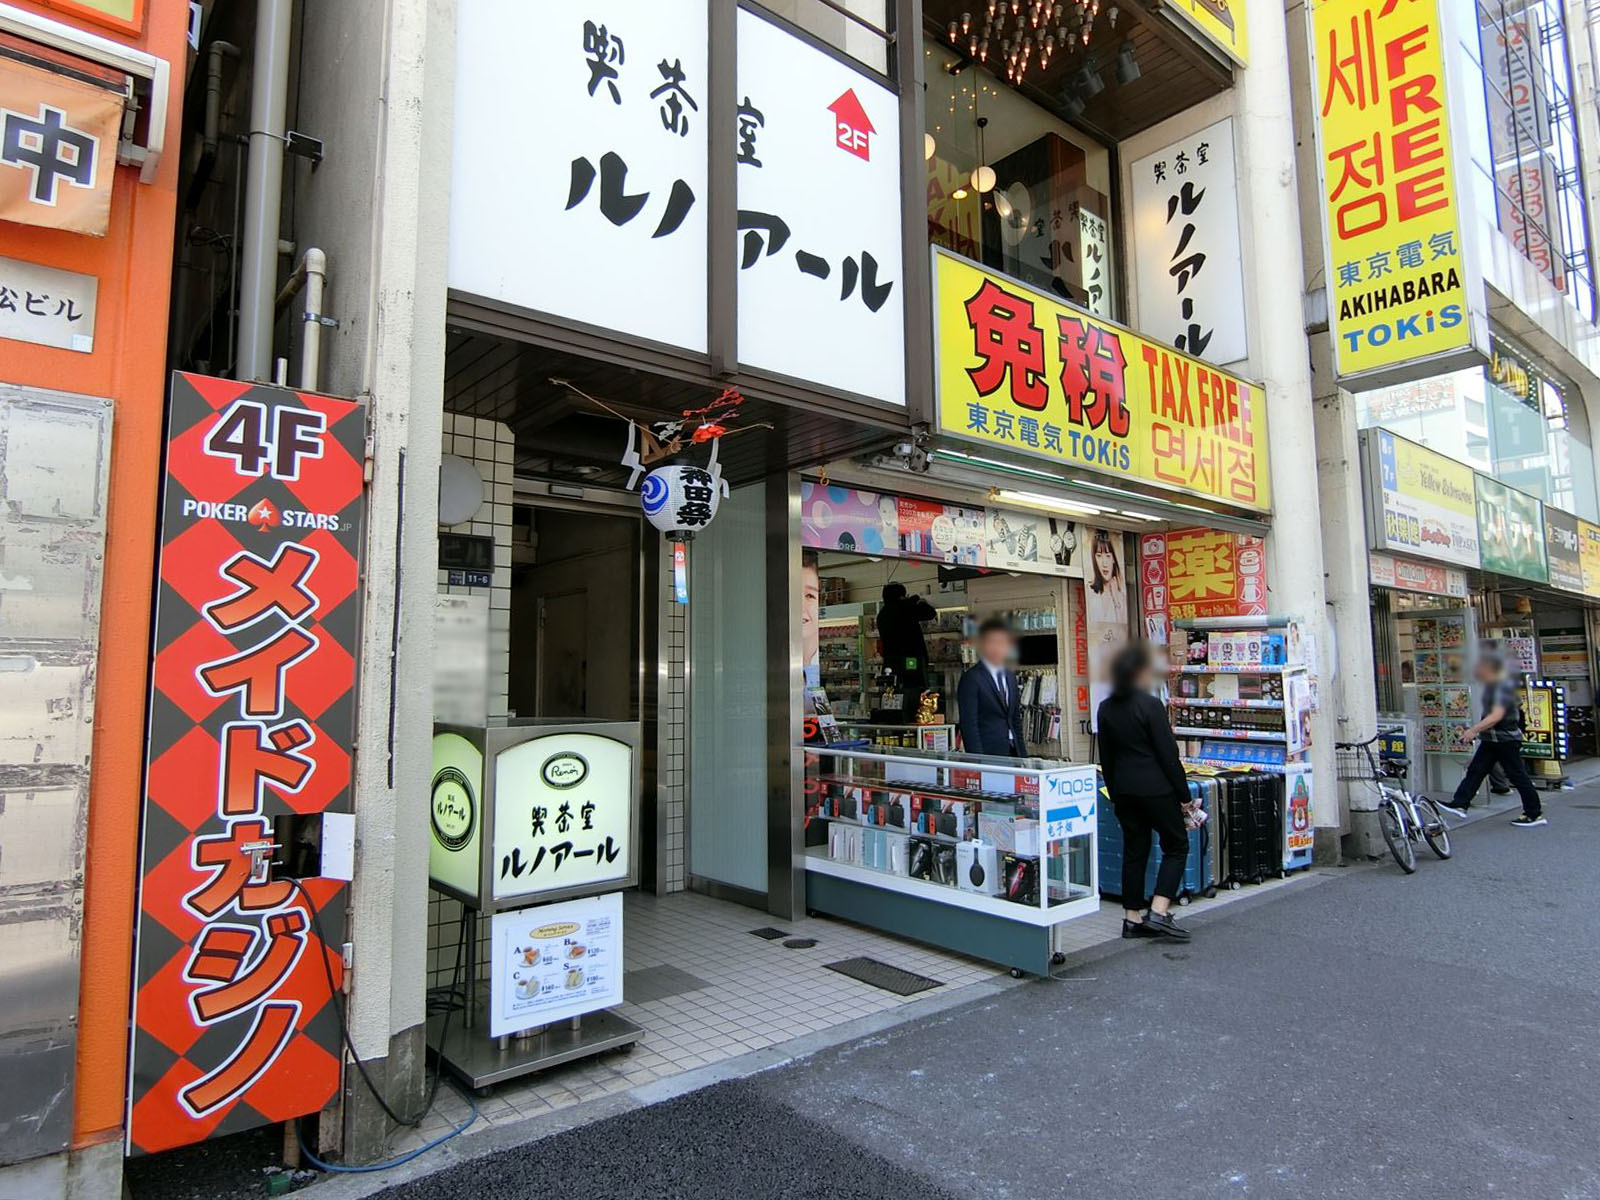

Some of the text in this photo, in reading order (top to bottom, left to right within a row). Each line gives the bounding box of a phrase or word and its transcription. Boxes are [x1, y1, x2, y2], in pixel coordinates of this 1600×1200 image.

[583, 19, 765, 168] 喫茶室
[1, 103, 99, 207] 中
[837, 121, 868, 150] 2F
[1153, 142, 1210, 184] 喫茶室
[564, 150, 895, 313] ルノアール
[1337, 230, 1458, 288] 東京電気
[1166, 182, 1214, 357] ルノアール
[1339, 267, 1461, 322] AKIHABARA
[963, 277, 1131, 439] 免税
[1343, 303, 1464, 353] TOKiS
[1141, 343, 1254, 448] TAX FREE
[203, 399, 328, 482] 4F
[966, 402, 1131, 471] 東京電気 TOKiS
[183, 499, 248, 522] POKER
[282, 509, 340, 532] STARS
[676, 466, 714, 527] 神田祭
[468, 574, 489, 584] 11-6
[1168, 531, 1235, 600] 薬
[1058, 777, 1095, 796] IQOS
[177, 541, 320, 1119] メイドカジノ
[532, 800, 597, 838] 喫茶室
[501, 835, 621, 880] ルノアール
